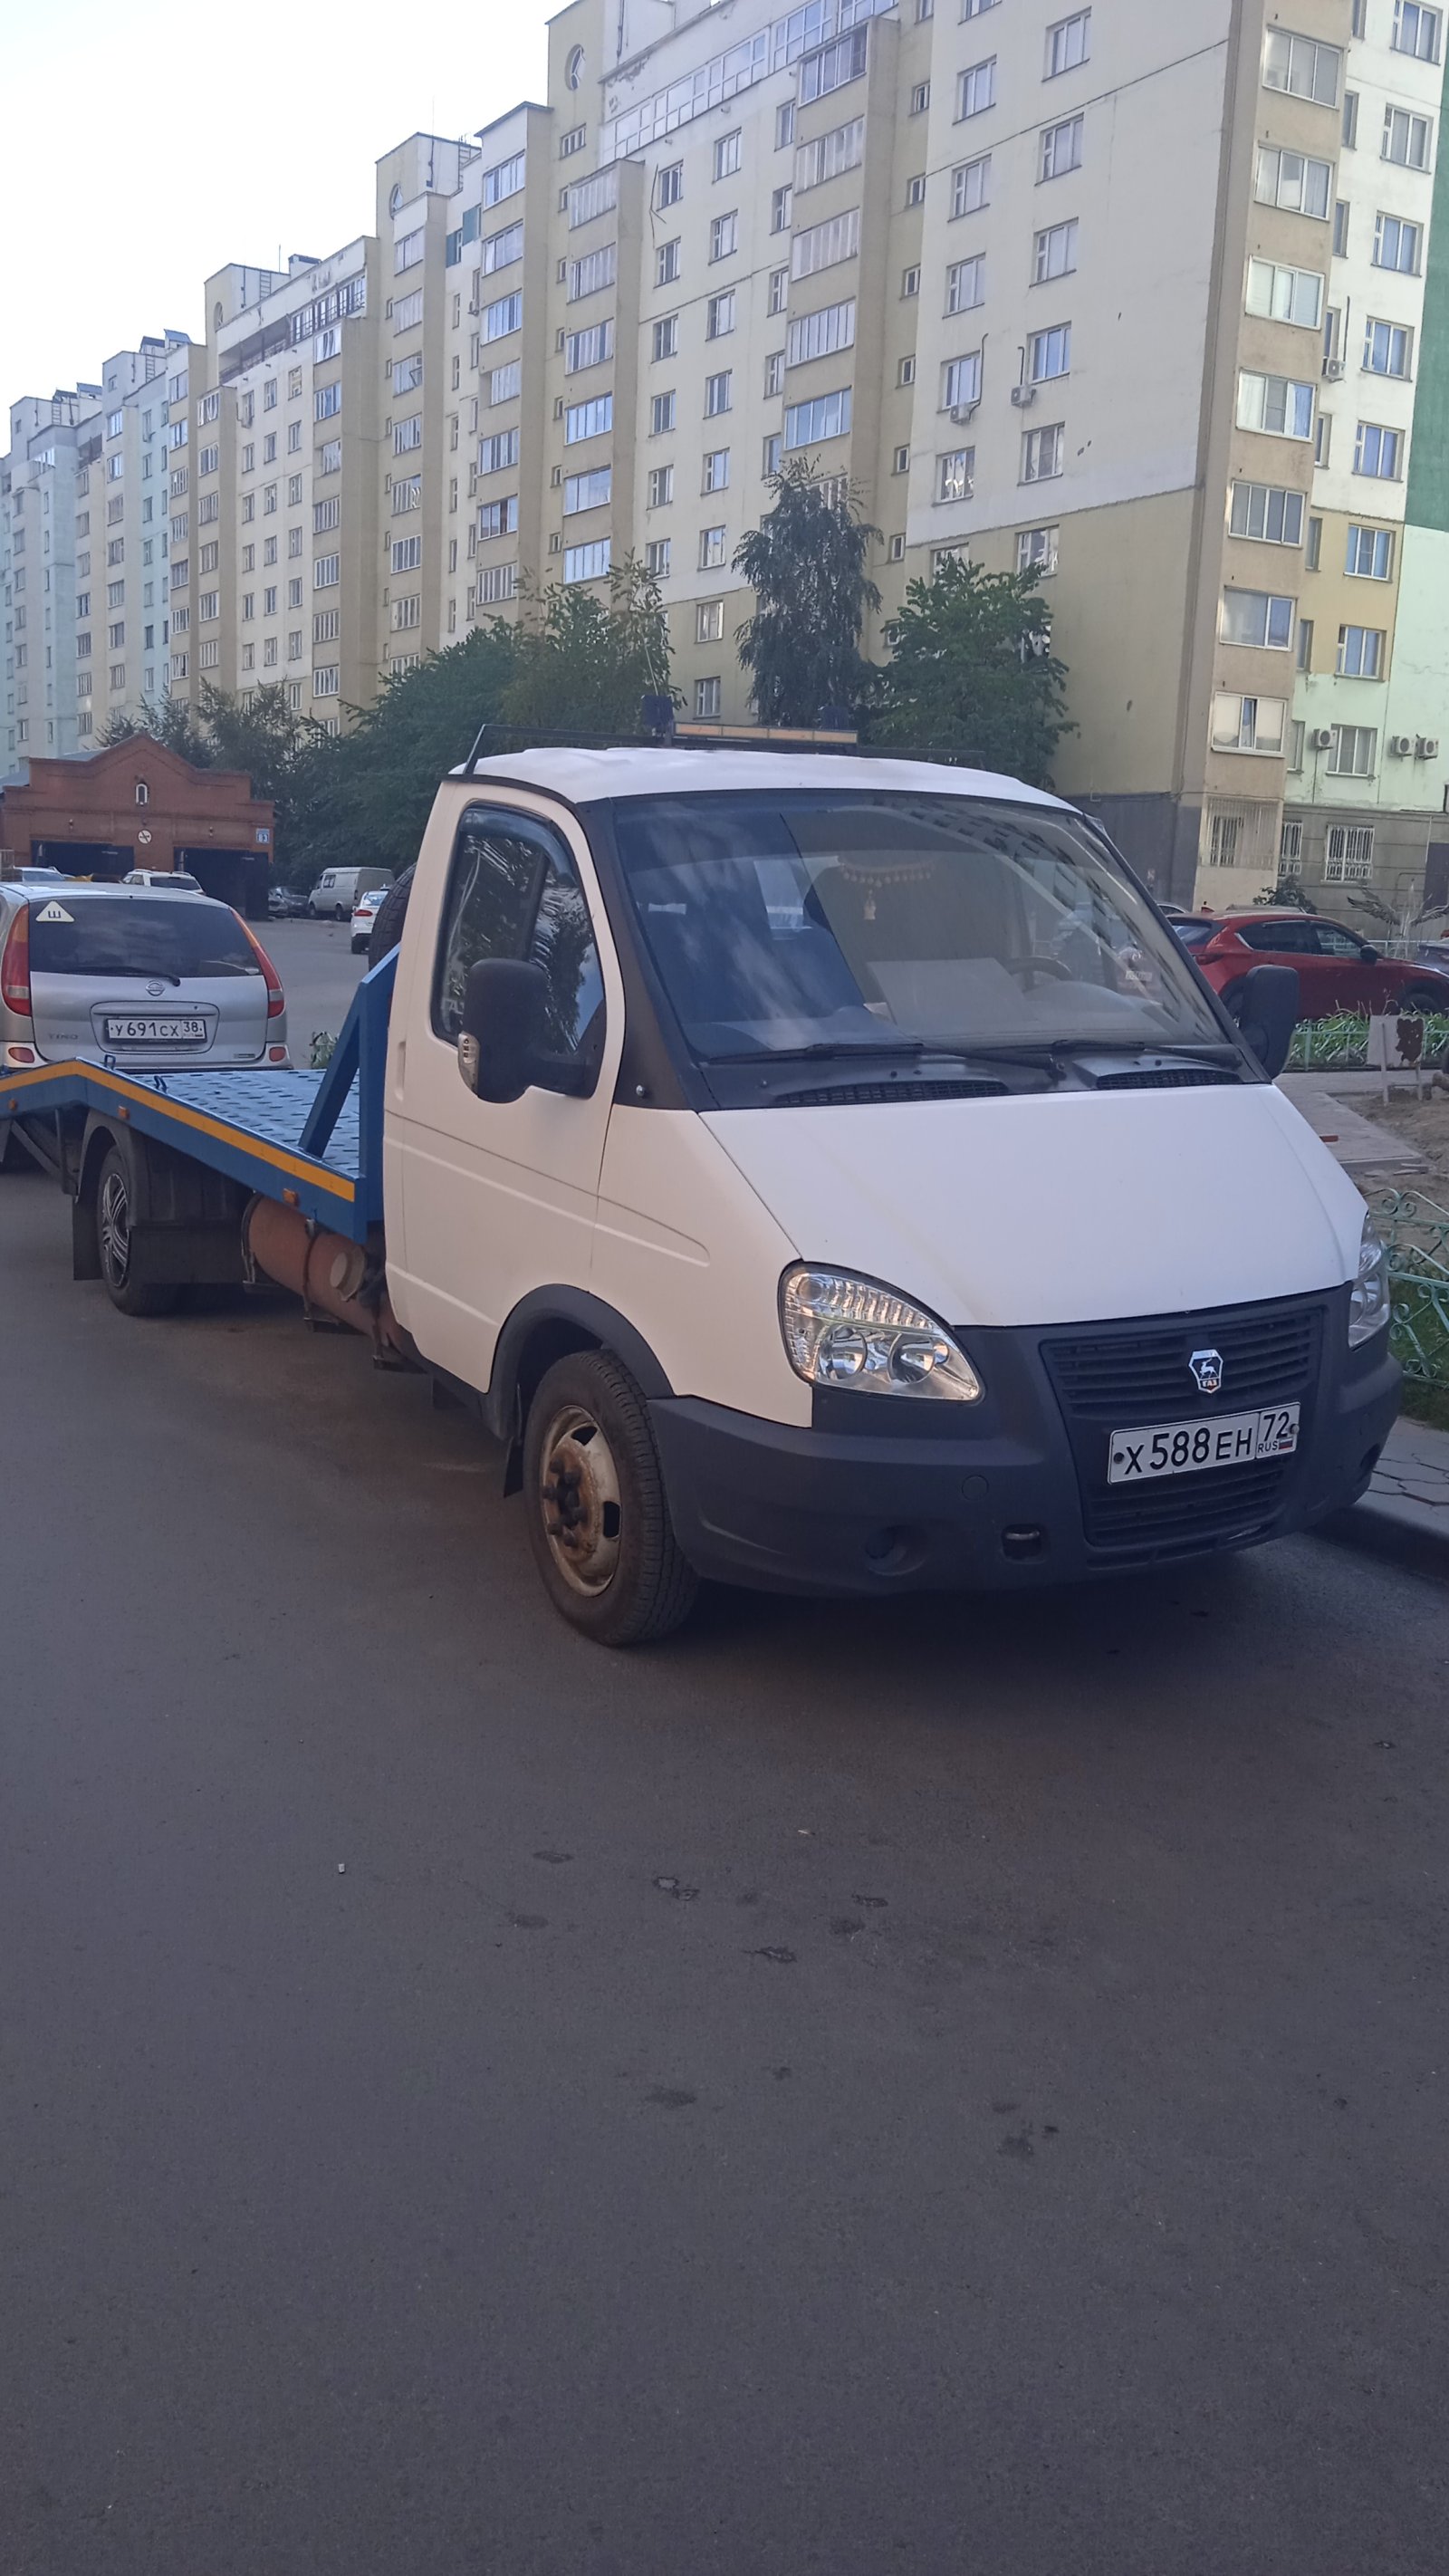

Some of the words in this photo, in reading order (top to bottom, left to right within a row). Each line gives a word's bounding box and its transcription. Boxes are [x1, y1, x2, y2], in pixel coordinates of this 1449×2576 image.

[48, 910, 61, 918] Ш
[183, 1022, 198, 1033] 38
[1263, 1411, 1290, 1441] 72
[1257, 1440, 1278, 1453] RUS
